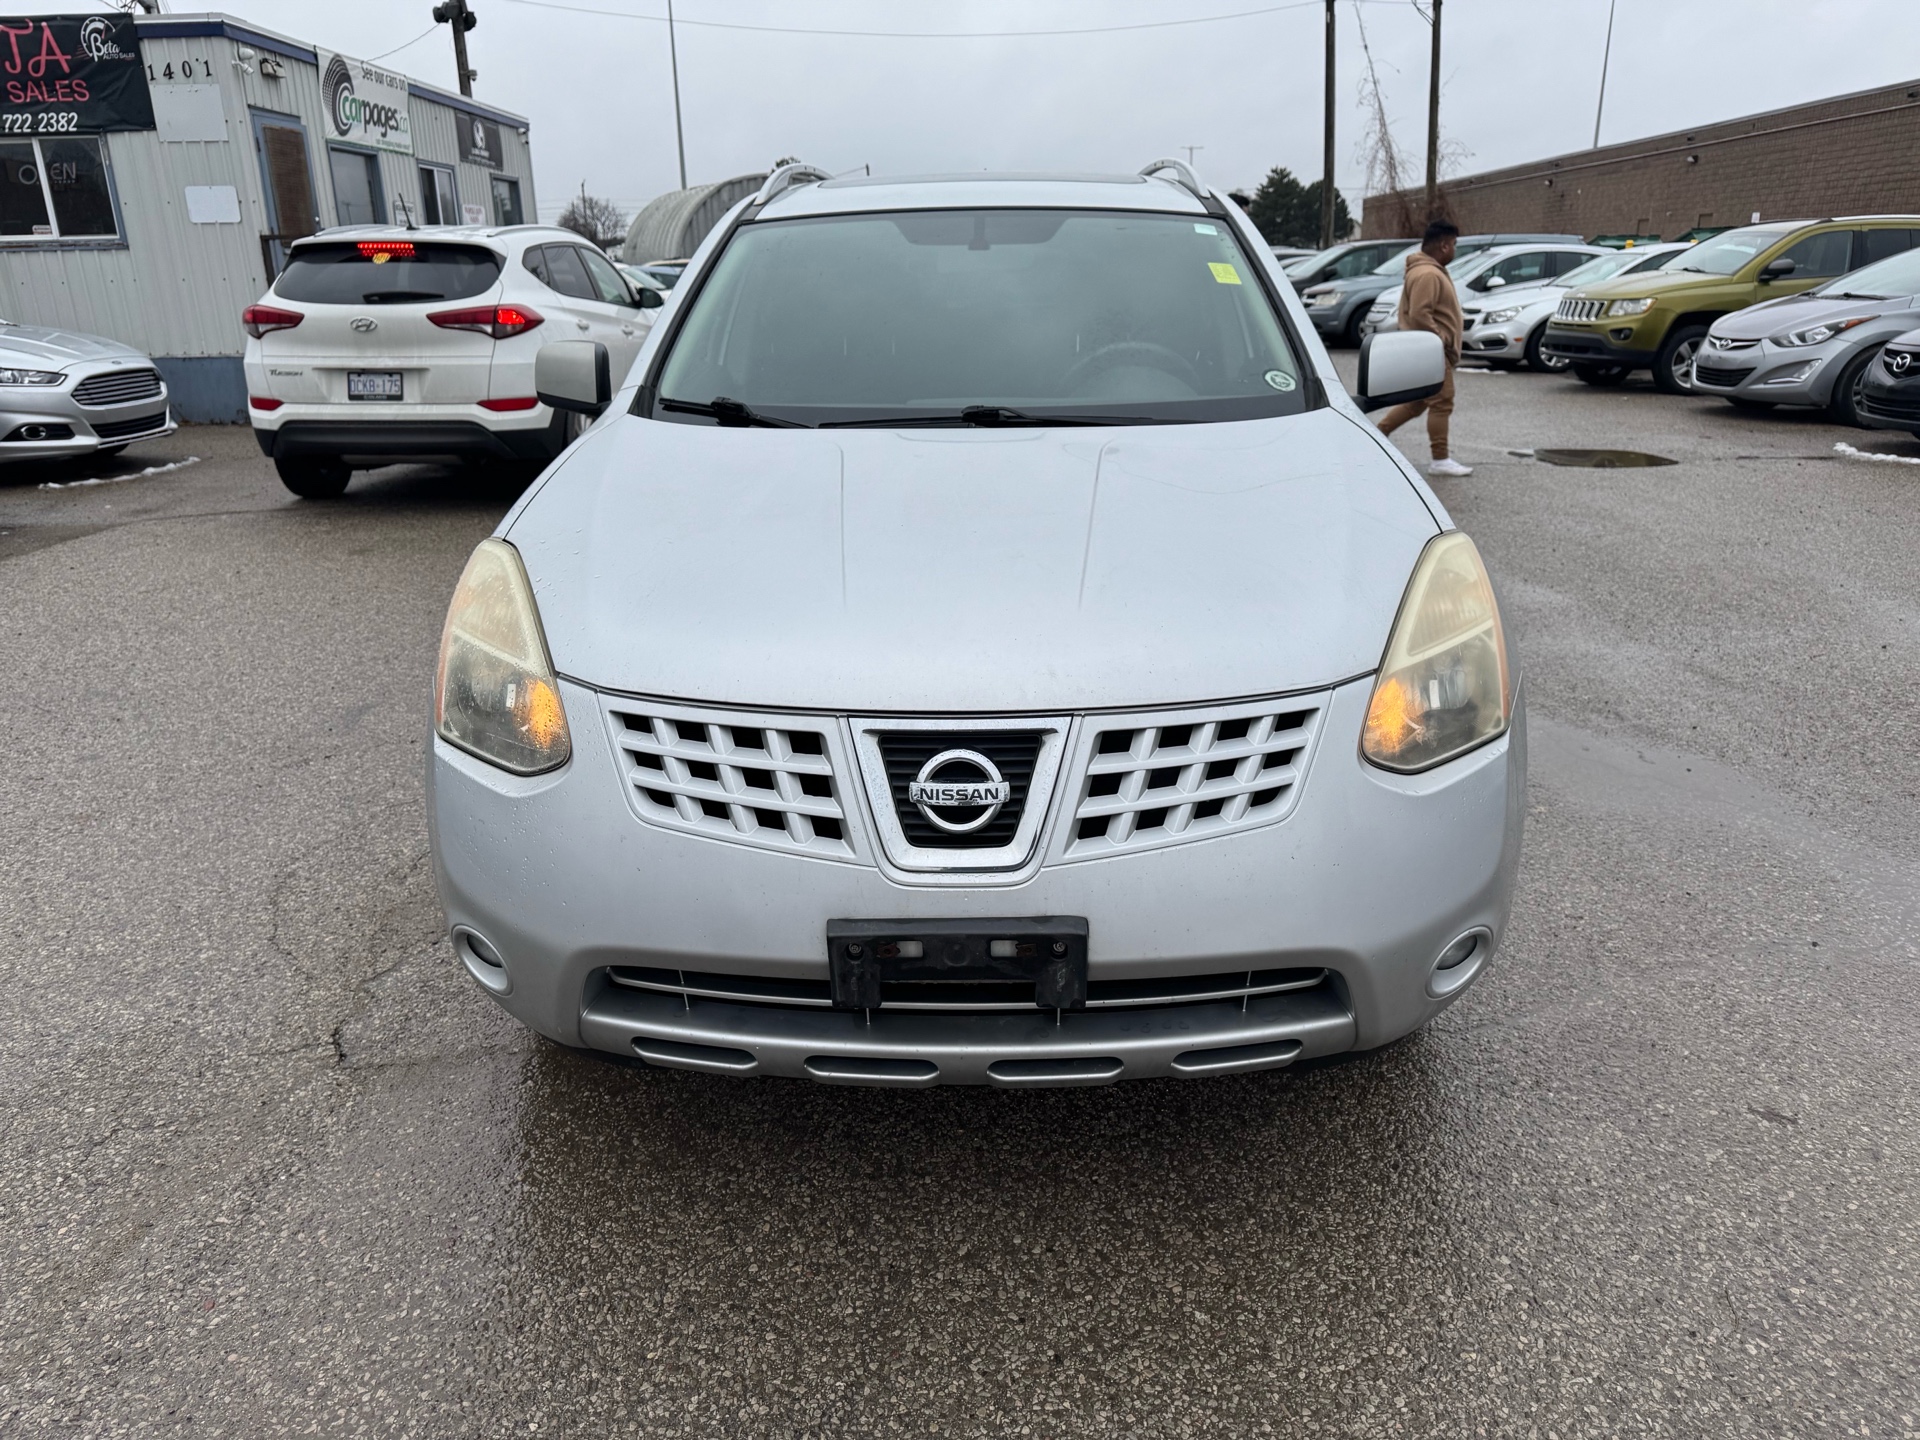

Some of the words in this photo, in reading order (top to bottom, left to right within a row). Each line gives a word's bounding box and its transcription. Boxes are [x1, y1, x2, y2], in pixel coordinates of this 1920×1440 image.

[147, 59, 213, 81] 1401
[374, 70, 384, 85] our
[385, 73, 399, 90] cars
[6, 80, 90, 103] SALES
[2, 113, 32, 133] 722
[38, 112, 78, 132] 2382
[18, 162, 76, 185] OEN
[920, 787, 999, 801] NISSAN
